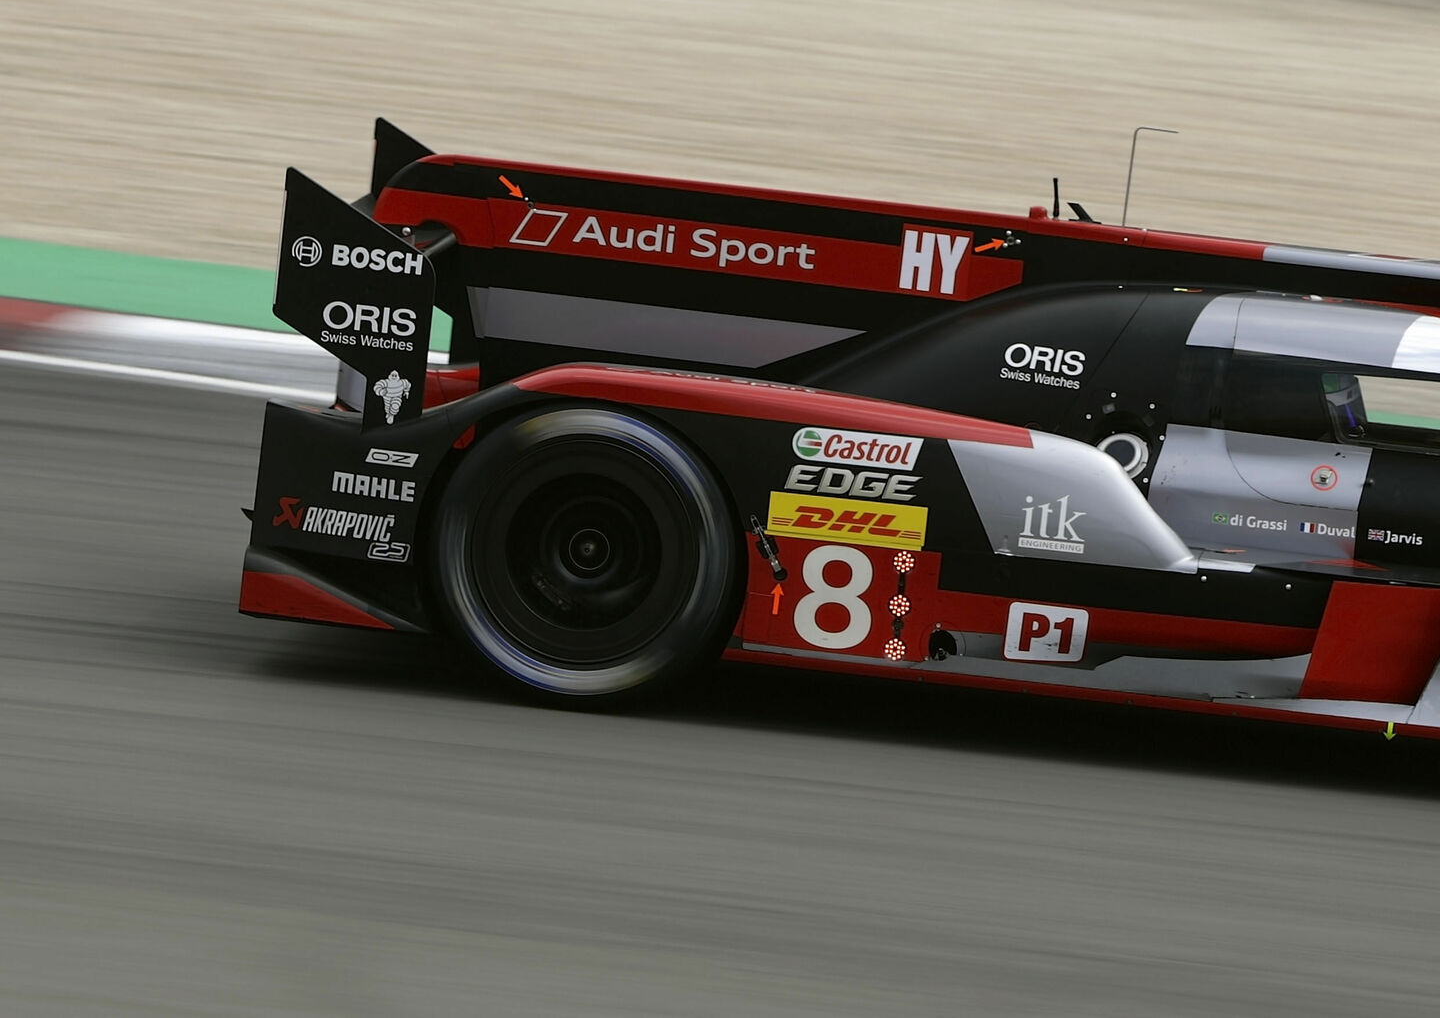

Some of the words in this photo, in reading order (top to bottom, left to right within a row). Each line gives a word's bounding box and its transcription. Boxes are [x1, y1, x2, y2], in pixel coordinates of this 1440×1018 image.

[572, 215, 676, 254] Audi
[690, 228, 816, 270] Sport
[332, 244, 423, 275] BOSCH
[899, 229, 971, 295] HY
[323, 301, 417, 336] ORIS
[320, 330, 357, 345] Swiss
[360, 334, 414, 352] Watches
[1004, 343, 1086, 376] ORIS
[1000, 367, 1031, 382] Swiss
[1034, 372, 1081, 390] Watches
[823, 434, 912, 465] Castrol
[332, 471, 416, 502] MAHLE
[784, 464, 923, 501] EDGE
[792, 506, 901, 537] DHL
[1019, 495, 1087, 542] itk
[1230, 514, 1243, 527] di
[1246, 516, 1288, 531] Grassi
[1317, 523, 1355, 539] Duval
[1020, 539, 1082, 553] ENGINEERING
[1385, 531, 1423, 545] Jarvis
[793, 545, 873, 649] 8
[1018, 612, 1075, 654] P1
